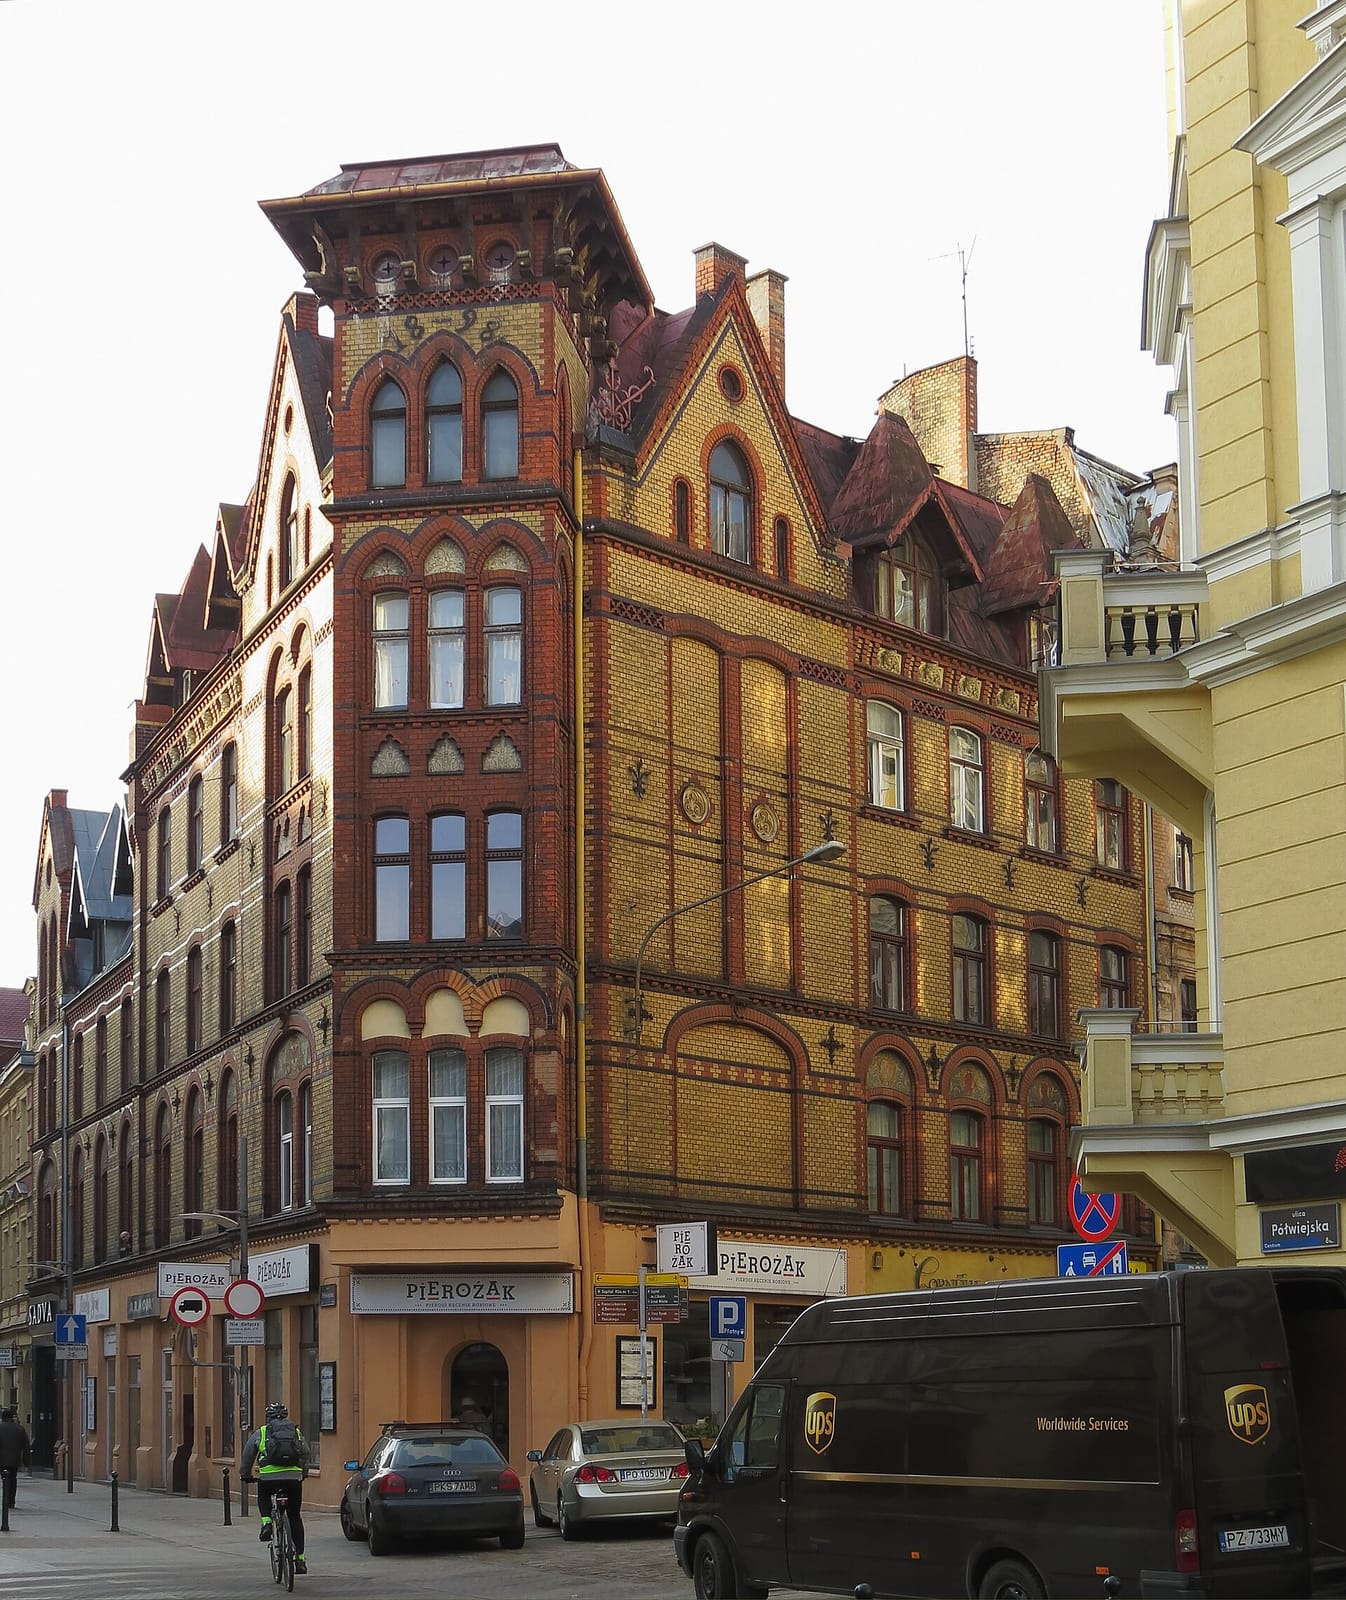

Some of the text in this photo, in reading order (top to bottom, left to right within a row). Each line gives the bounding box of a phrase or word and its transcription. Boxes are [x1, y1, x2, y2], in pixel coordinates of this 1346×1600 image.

[1291, 1210, 1306, 1218] ulica
[1271, 1219, 1329, 1237] Półwiejska
[671, 1255, 694, 1268] ŻAK
[718, 1301, 739, 1334] P
[807, 1411, 833, 1445] ups
[1037, 1416, 1129, 1431] Worldwide Services
[1229, 1402, 1268, 1436] ups
[626, 1470, 638, 1479] PO
[1227, 1527, 1285, 1547] PZ 733MY
